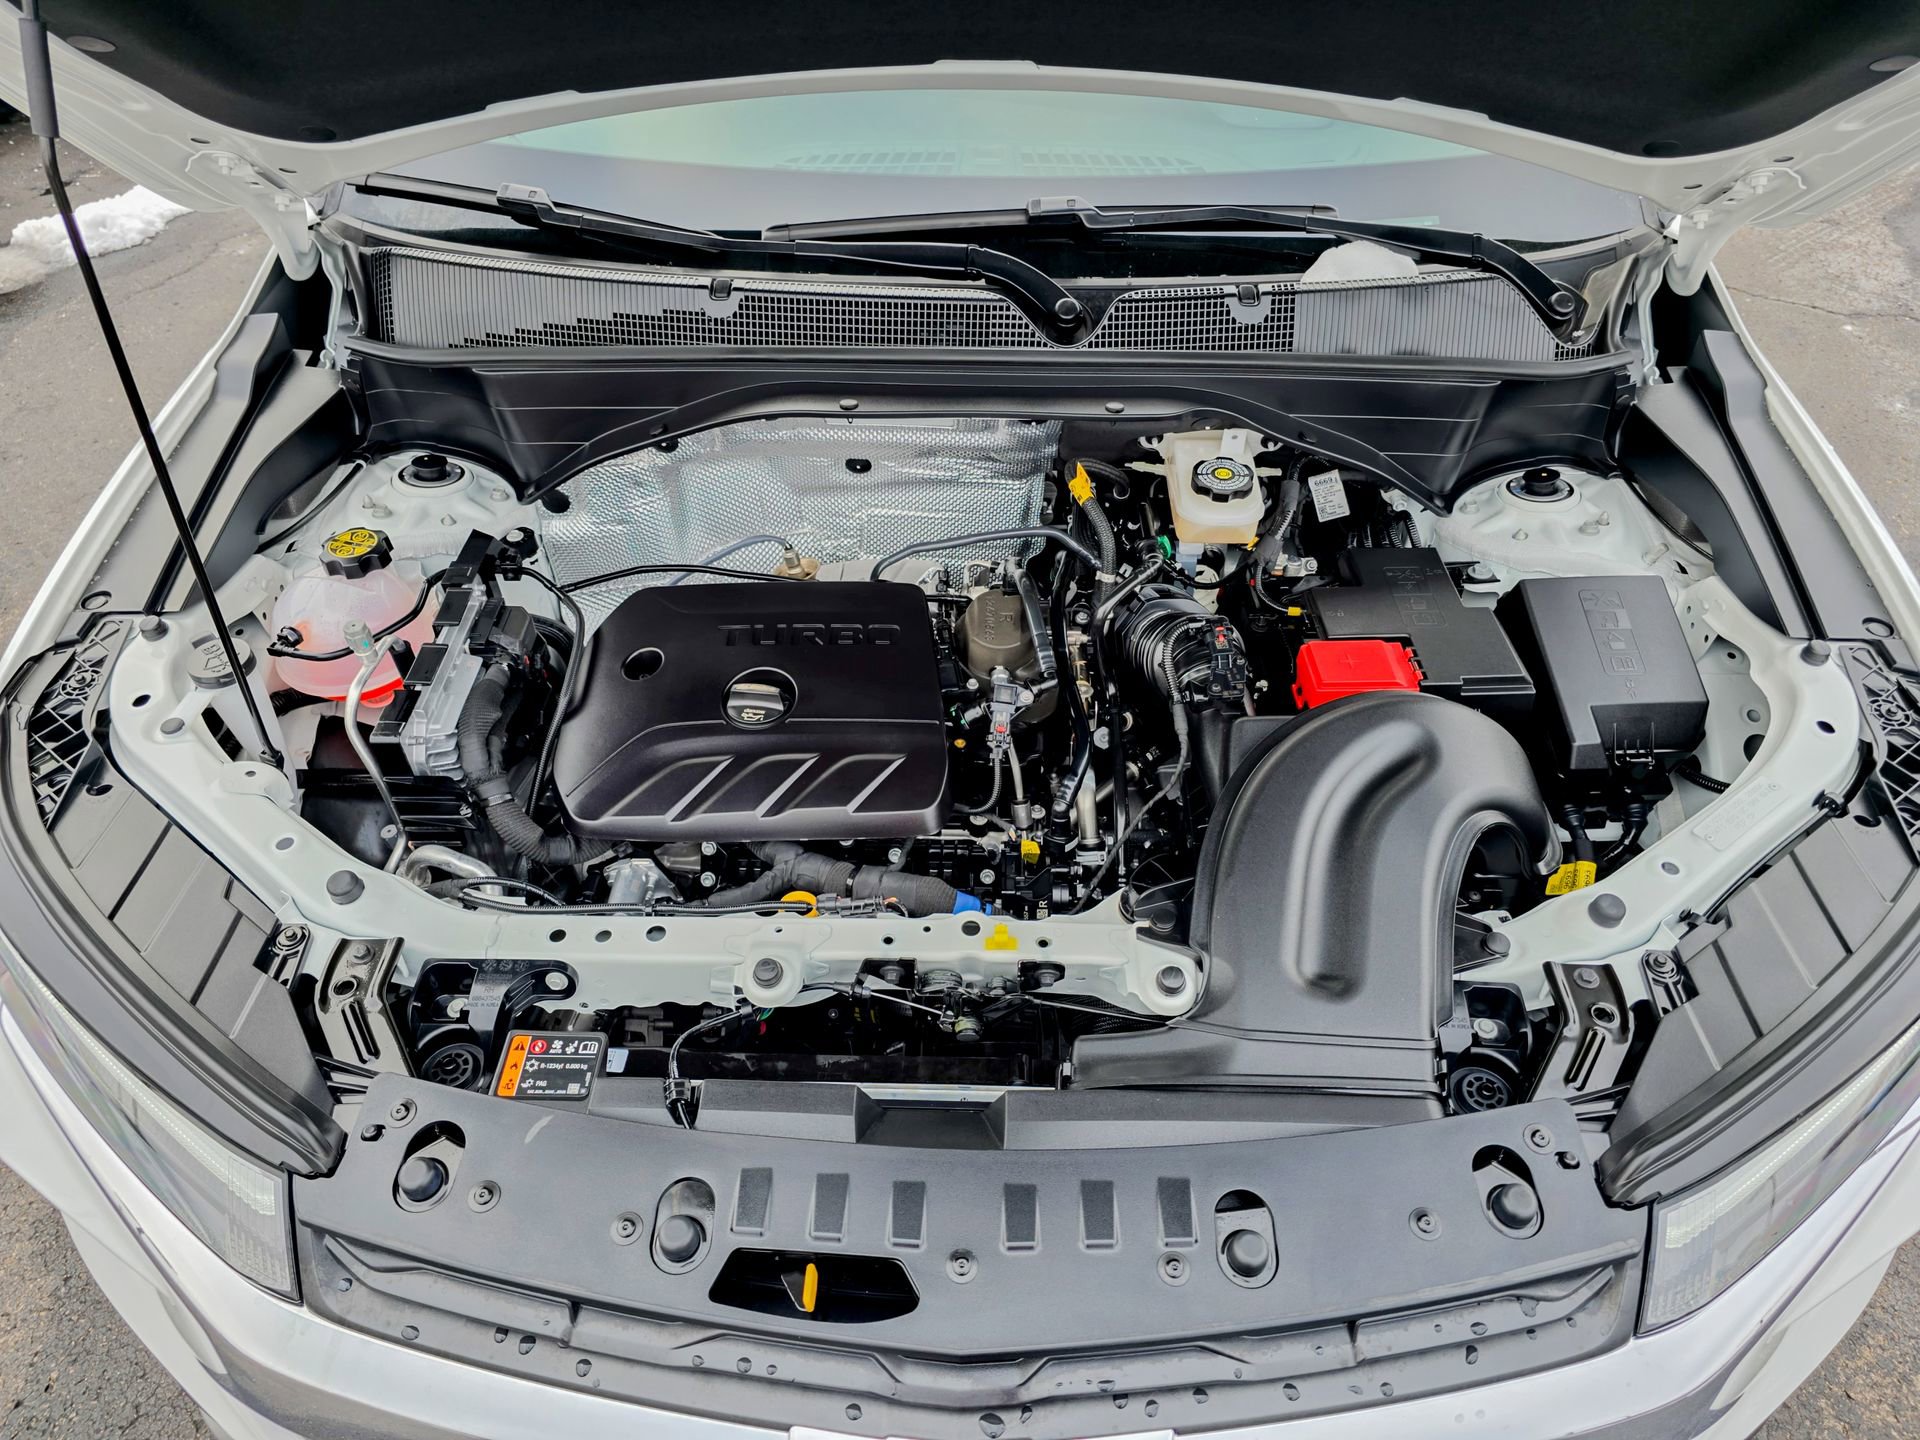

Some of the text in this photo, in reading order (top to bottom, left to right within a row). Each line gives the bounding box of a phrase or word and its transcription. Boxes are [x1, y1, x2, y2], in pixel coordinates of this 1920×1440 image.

[999, 612, 1014, 624] R
[717, 623, 901, 647] TURBO
[1038, 900, 1048, 908] R
[483, 985, 495, 993] RH
